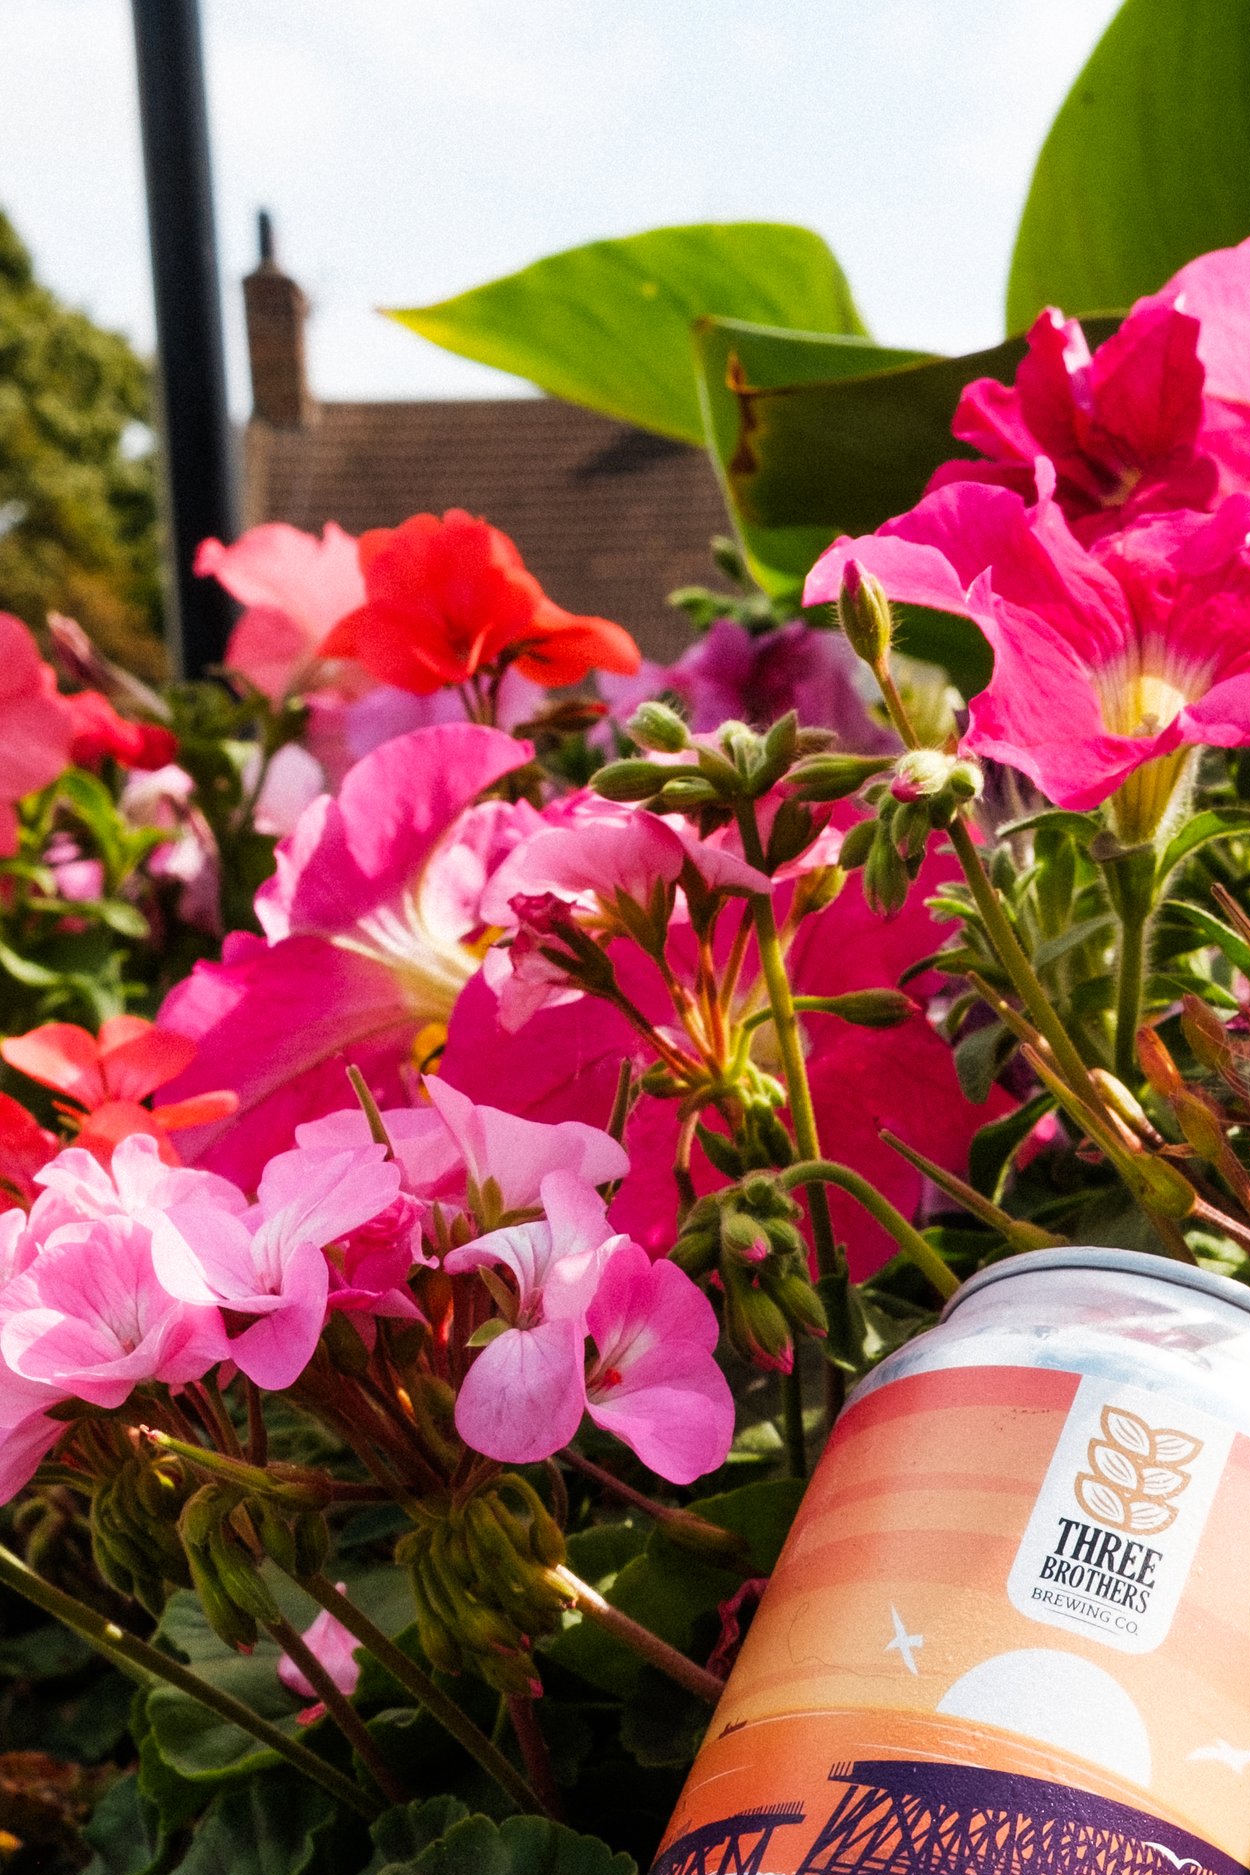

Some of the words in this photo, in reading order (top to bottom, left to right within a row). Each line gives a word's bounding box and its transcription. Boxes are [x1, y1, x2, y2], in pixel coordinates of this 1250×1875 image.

[1054, 1517, 1163, 1589] THREE
[1031, 1587, 1111, 1623] BREWING
[1113, 1615, 1139, 1637] CO.
[1039, 1556, 1151, 1614] BROTHERS
